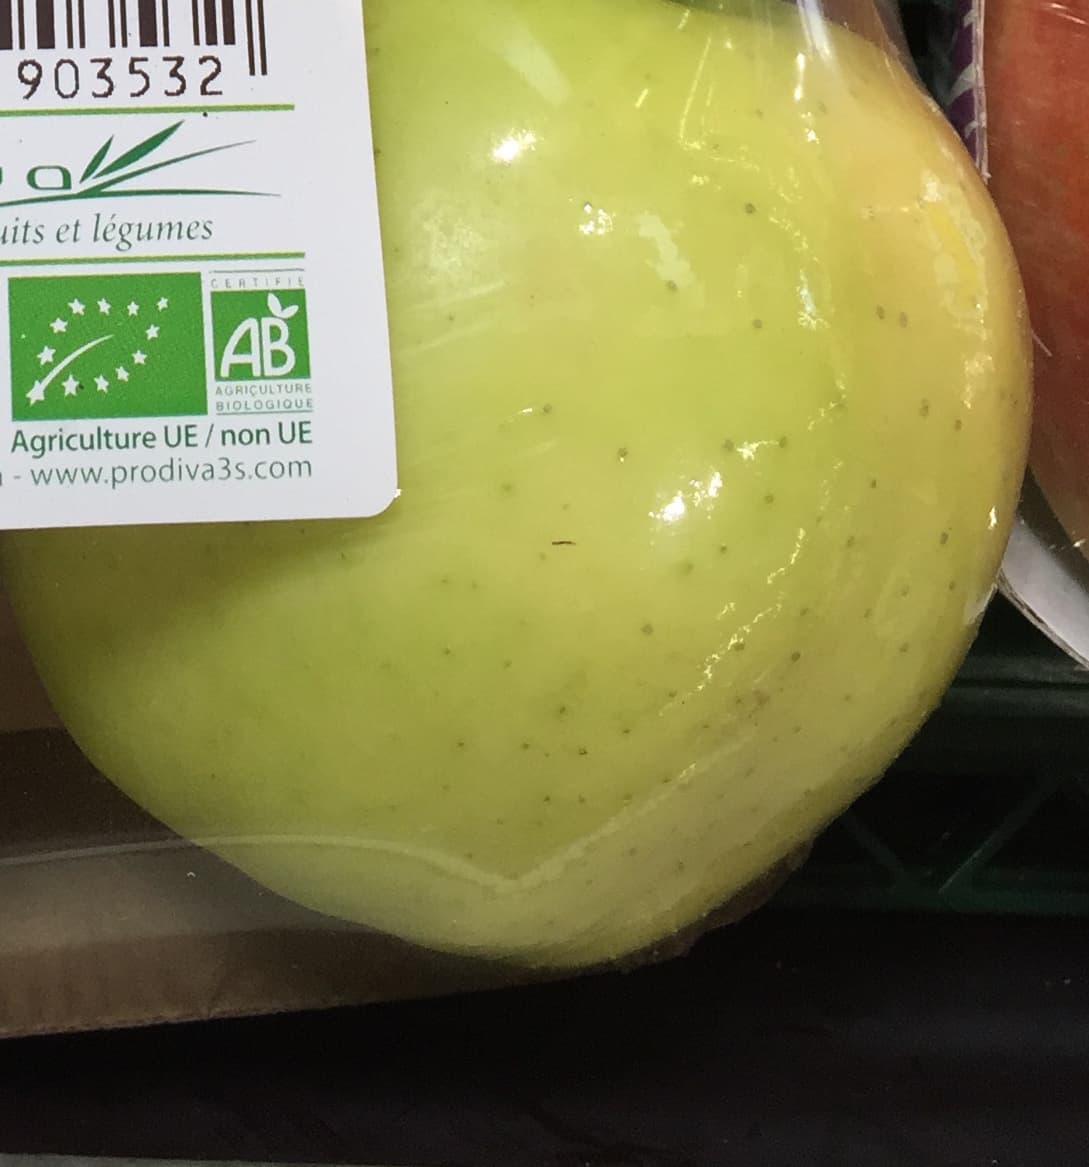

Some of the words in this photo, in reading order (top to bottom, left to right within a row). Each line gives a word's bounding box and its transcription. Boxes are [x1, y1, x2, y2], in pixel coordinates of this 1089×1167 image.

[18, 55, 223, 100] 903532
[56, 219, 80, 243] et
[93, 213, 212, 252] légumes
[220, 317, 296, 377] AB
[216, 384, 312, 395] AGRICULTURE
[216, 399, 313, 411] BIOLOGIQUE
[11, 426, 156, 458] Agriculture
[164, 424, 198, 448] UE
[205, 424, 214, 448] /
[221, 428, 270, 446] non
[278, 421, 312, 444] UE
[31, 453, 311, 490] www.prodiva3s.com
